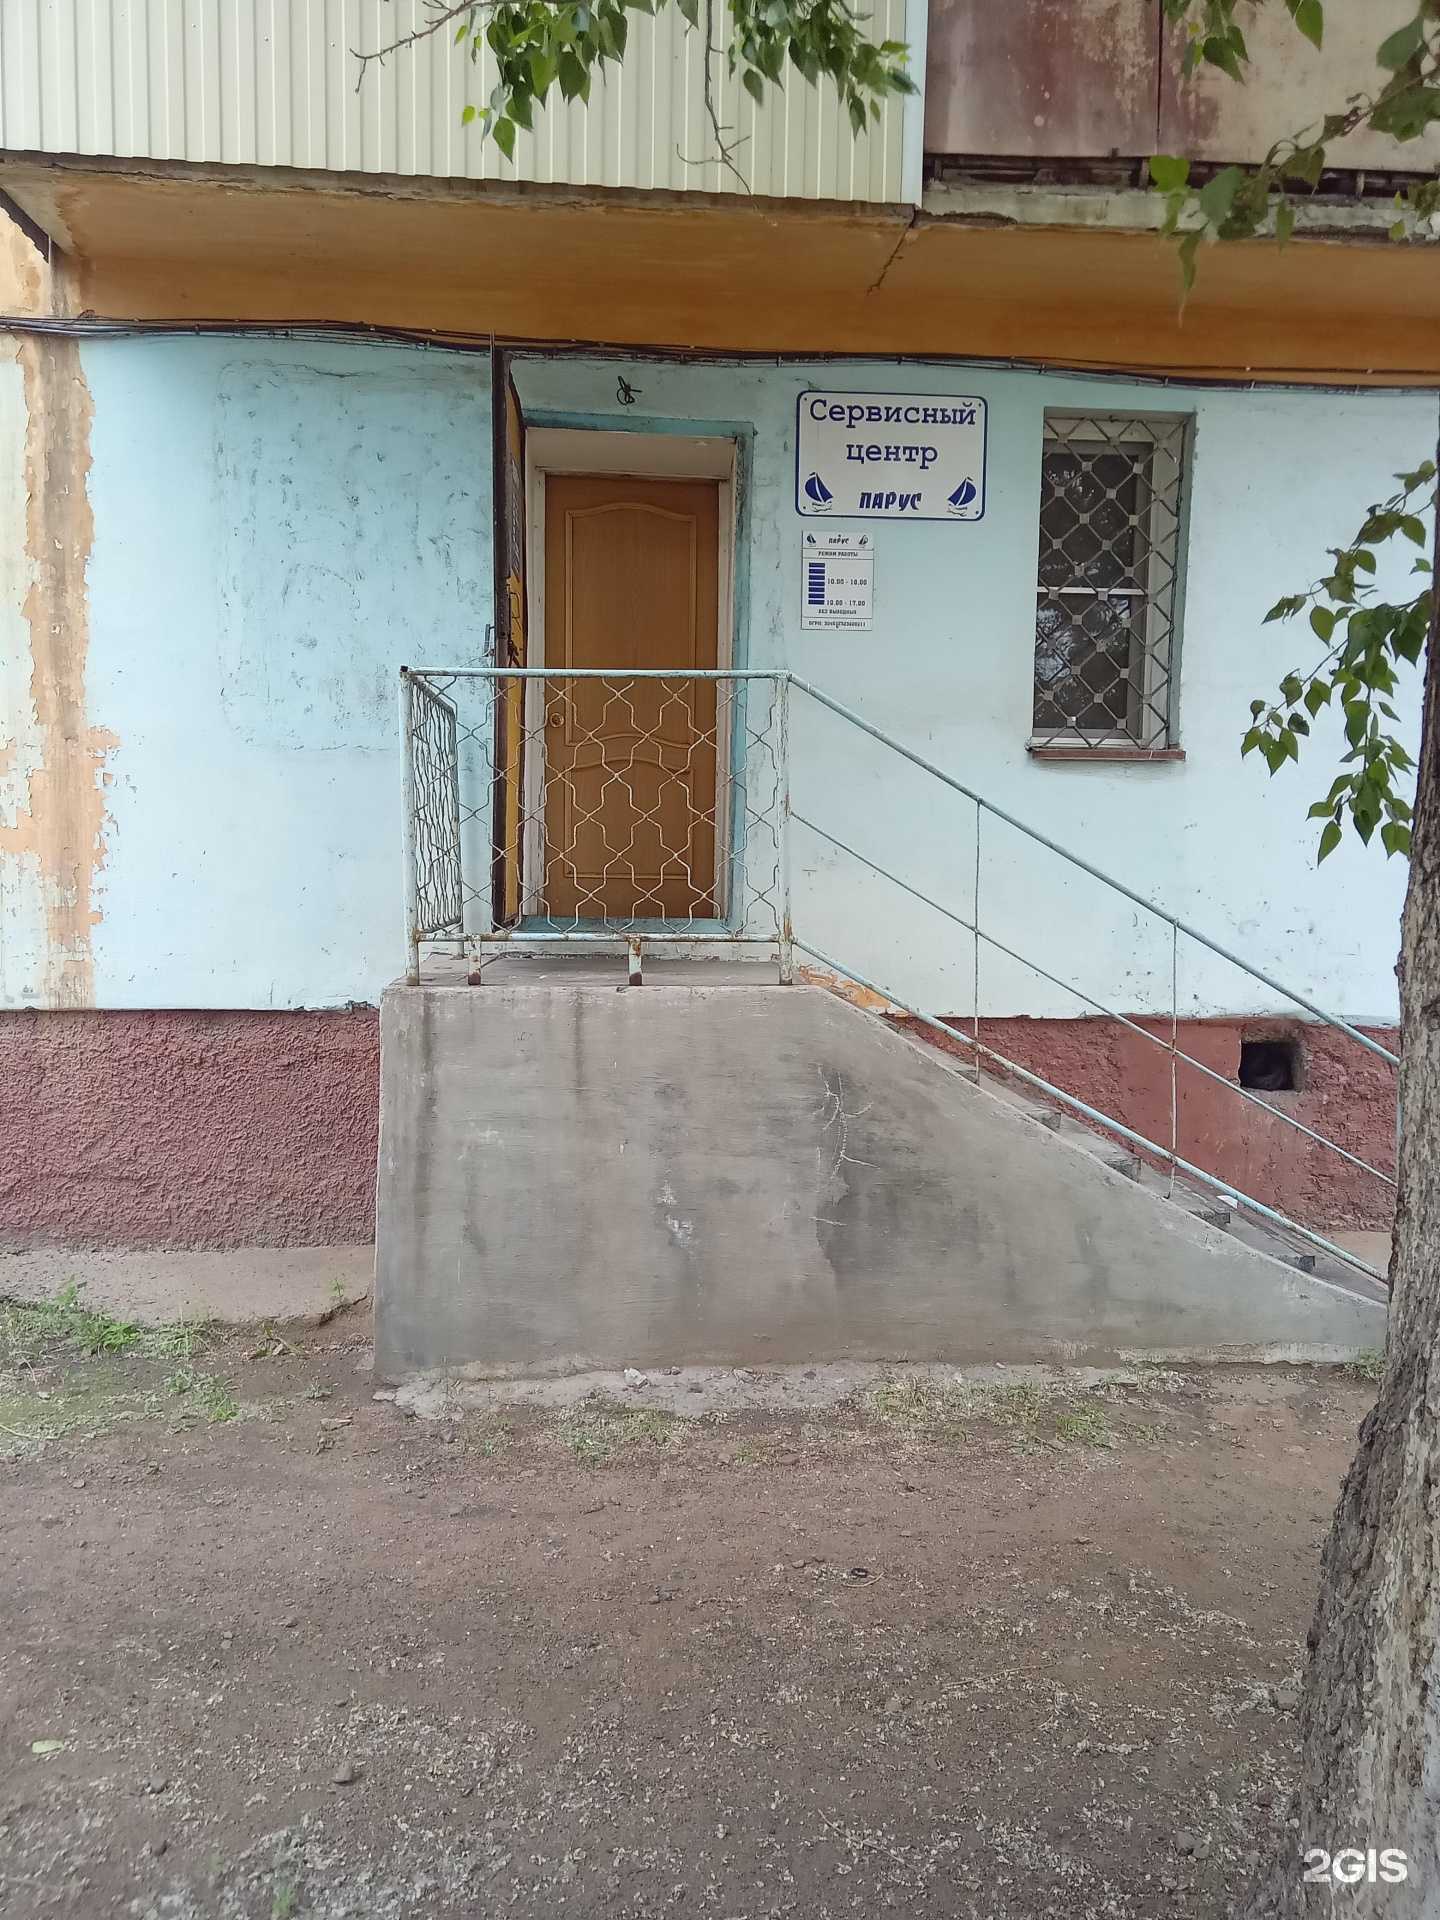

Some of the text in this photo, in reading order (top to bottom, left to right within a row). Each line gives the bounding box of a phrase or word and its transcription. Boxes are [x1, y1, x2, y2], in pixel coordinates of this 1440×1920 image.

[809, 398, 977, 429] Сервисный
[846, 443, 938, 470] центр
[859, 491, 922, 511] ПАРУС
[828, 537, 850, 545] ПАРУС
